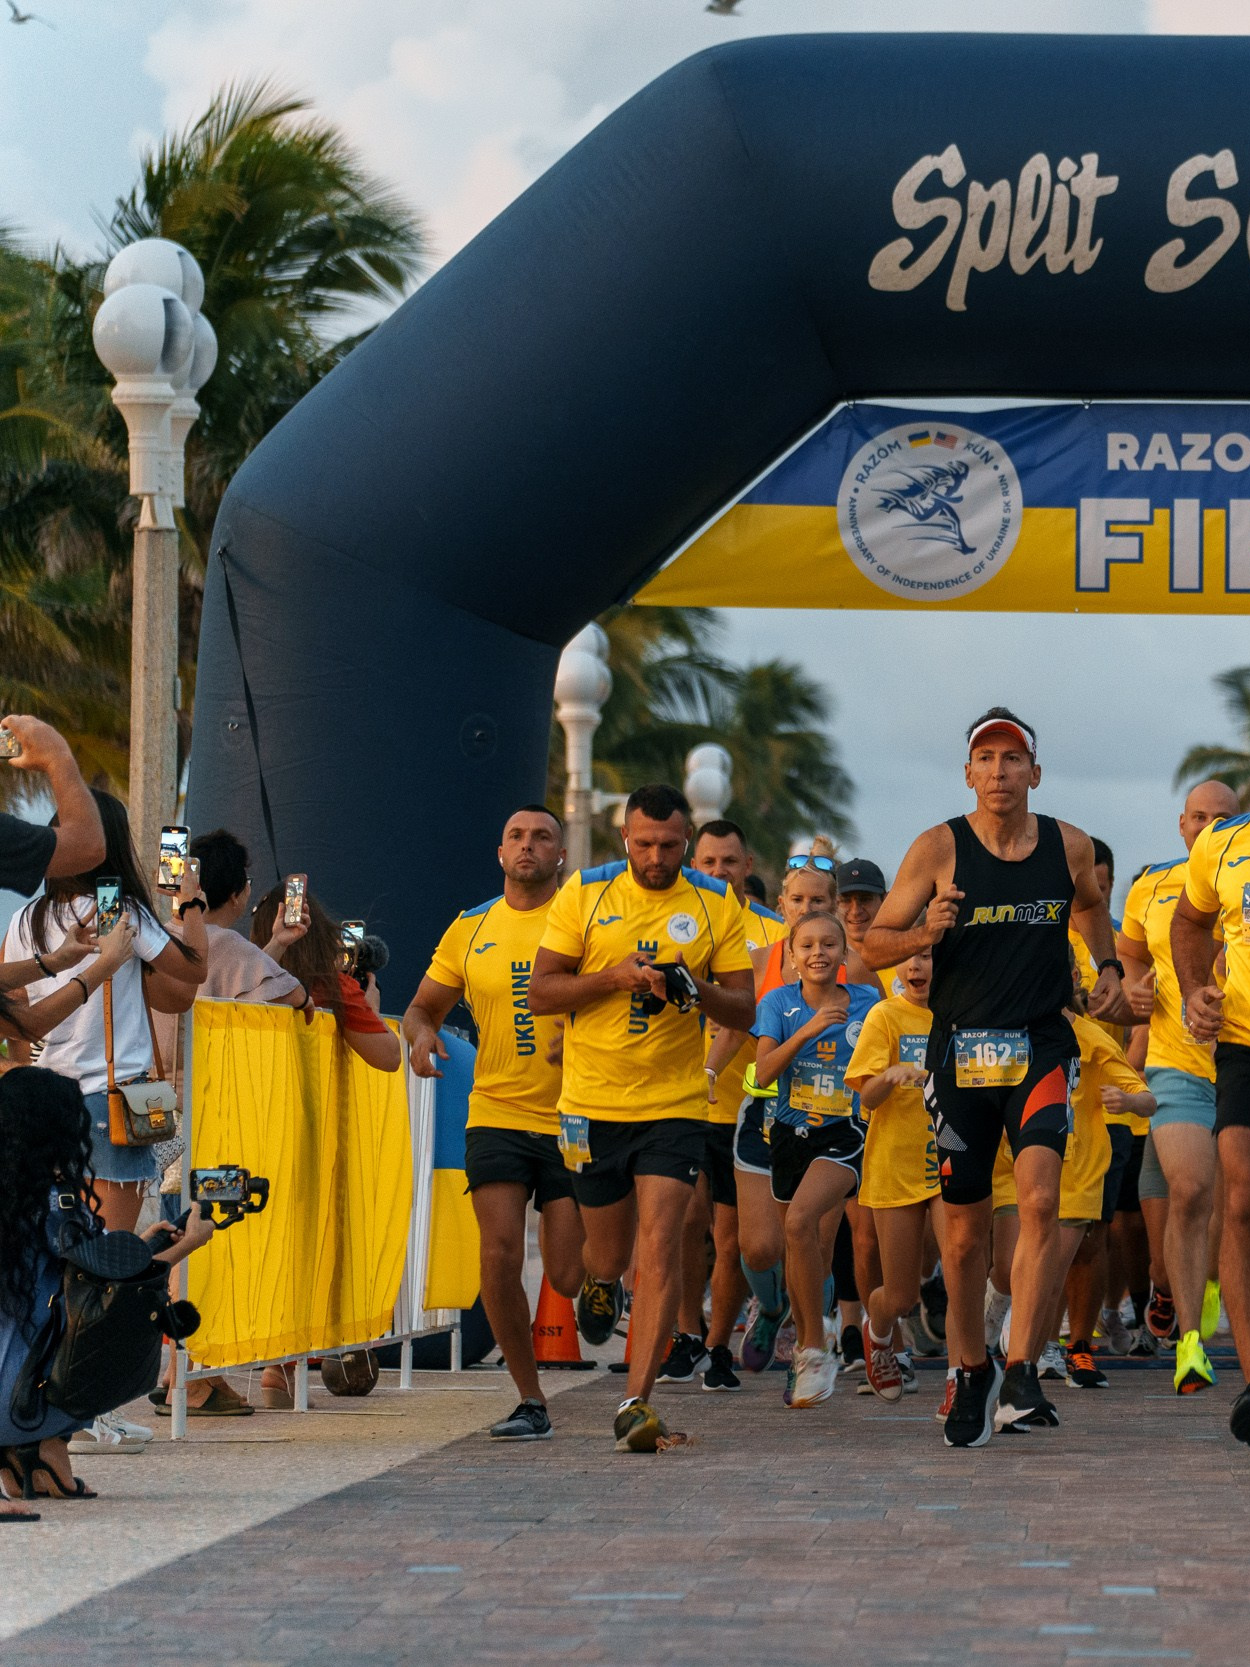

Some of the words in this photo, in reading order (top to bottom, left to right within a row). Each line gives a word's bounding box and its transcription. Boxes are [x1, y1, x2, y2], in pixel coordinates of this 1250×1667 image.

[868, 143, 1119, 312] Split
[855, 440, 903, 485] RAZOM
[963, 441, 994, 465] RUN
[997, 474, 1010, 498] RUN
[848, 496, 878, 565] ANNIVERSARY
[987, 517, 1011, 562] UKRAINE
[876, 565, 892, 578] OF
[973, 561, 987, 575] OF
[892, 571, 973, 591] INDEPENDENCE
[511, 960, 537, 1057] UKRAINE
[962, 1031, 988, 1039] RAZOM
[797, 1061, 823, 1070] RAZOM
[971, 1042, 1012, 1068] 162
[811, 1073, 835, 1097] 15
[539, 1325, 563, 1337] SST
